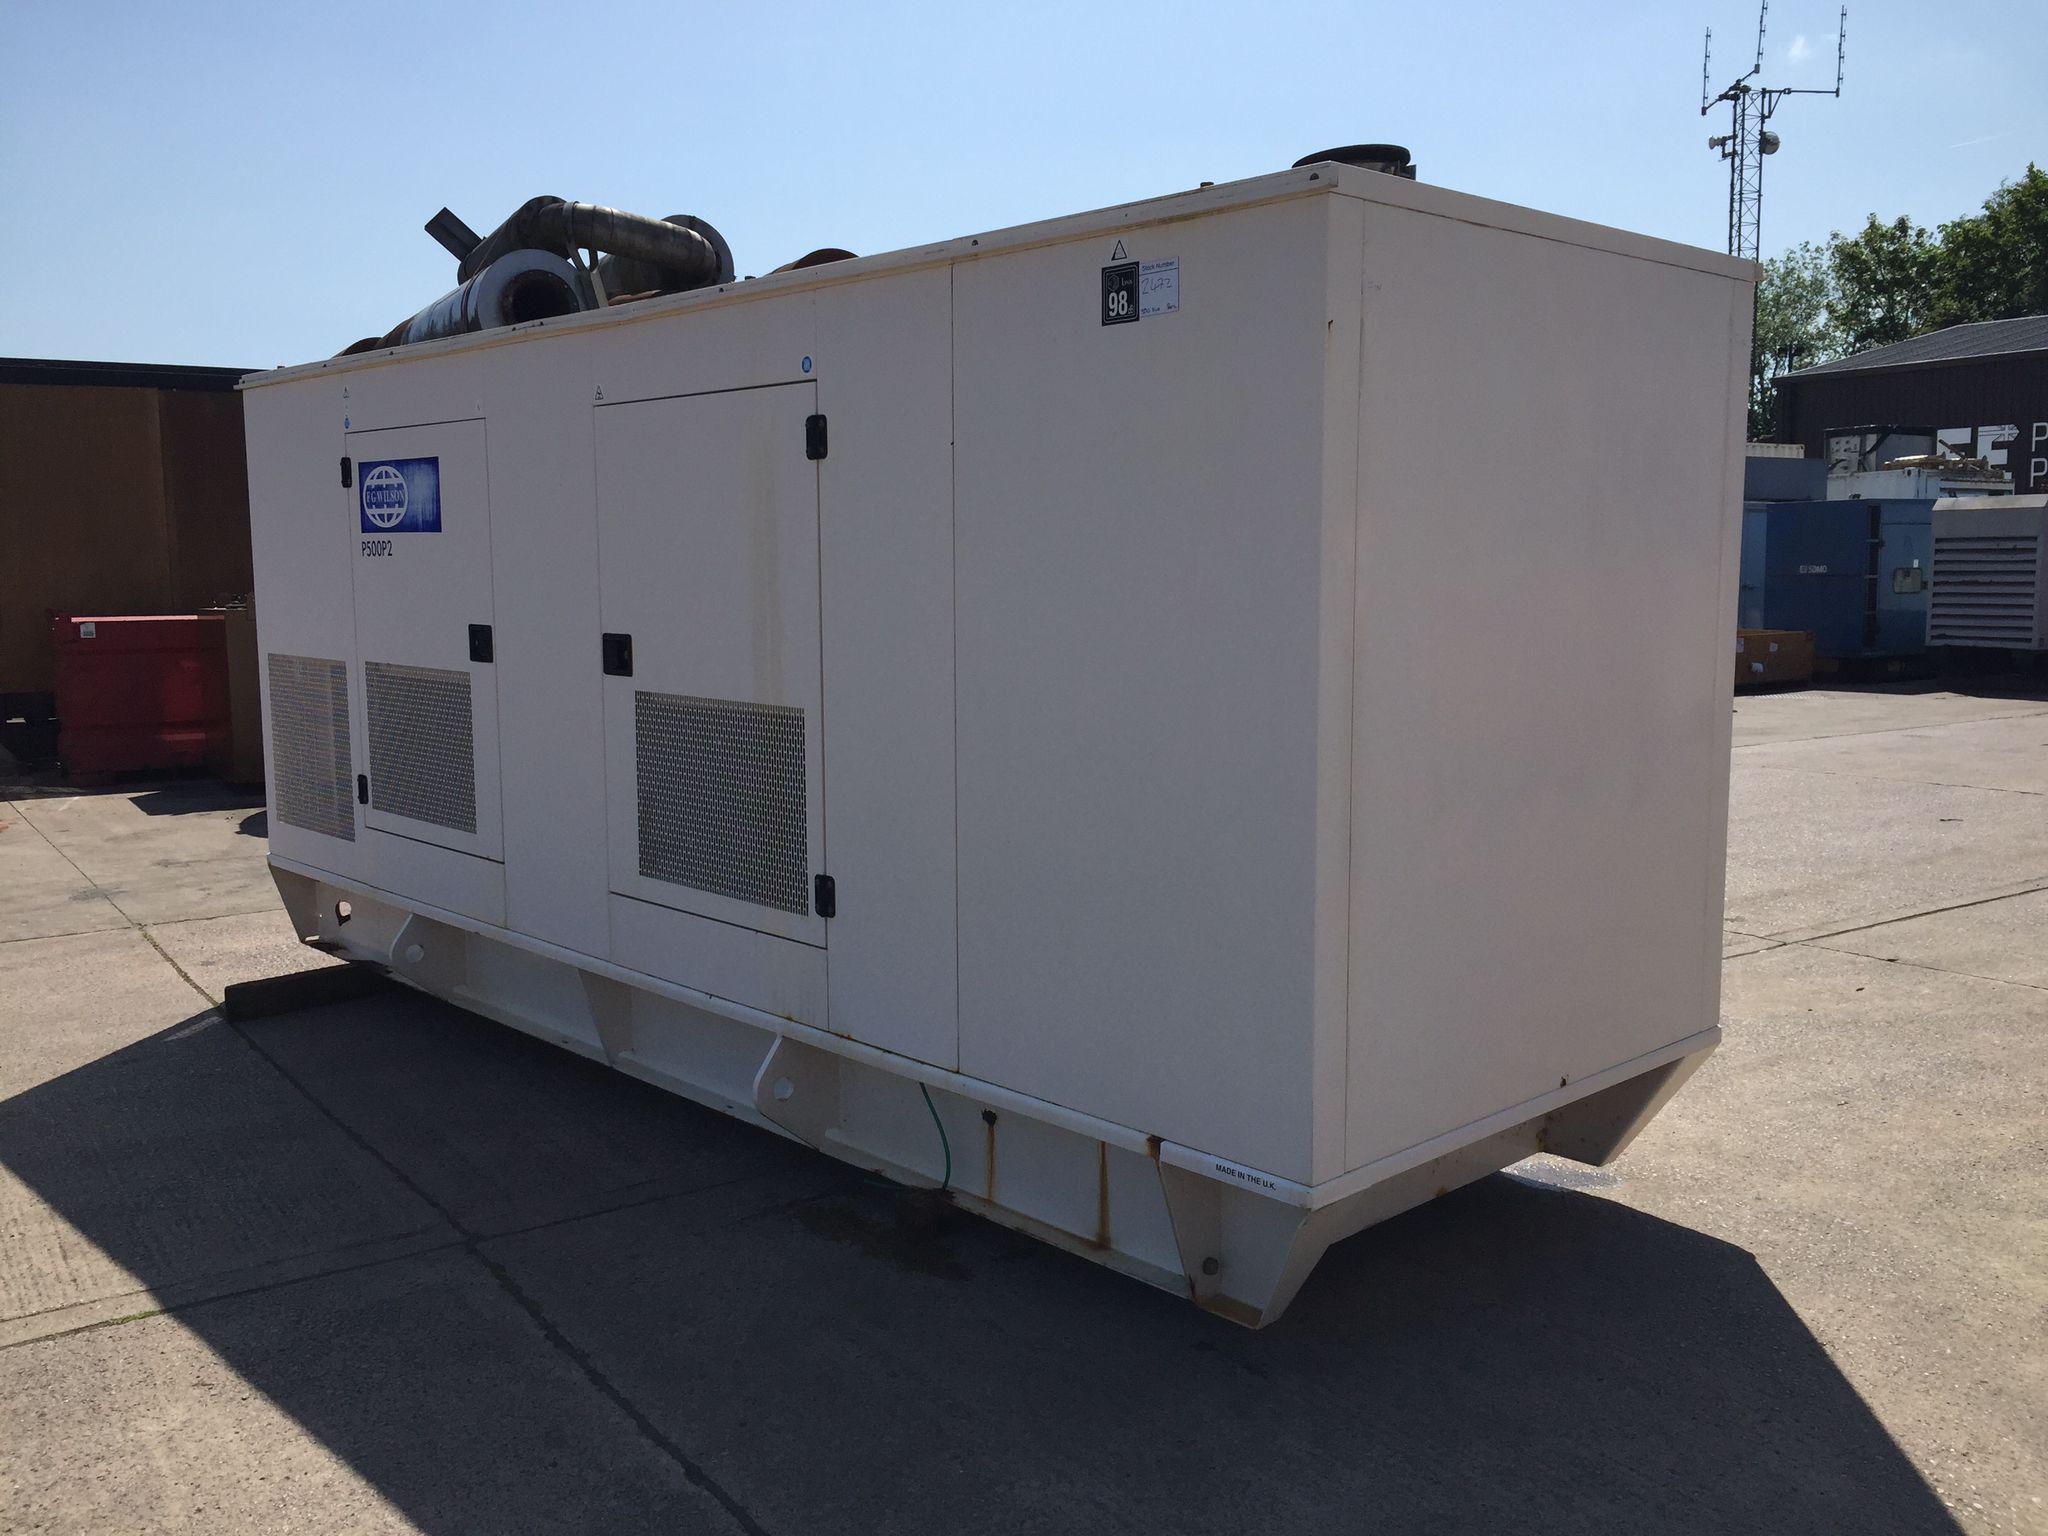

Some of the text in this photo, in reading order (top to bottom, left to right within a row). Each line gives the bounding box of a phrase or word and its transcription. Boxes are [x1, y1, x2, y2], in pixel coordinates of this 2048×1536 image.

[1108, 290, 1128, 317] 98
[361, 540, 393, 557] P500P2
[1215, 1163, 1277, 1191] MADE IN THE U.K.
